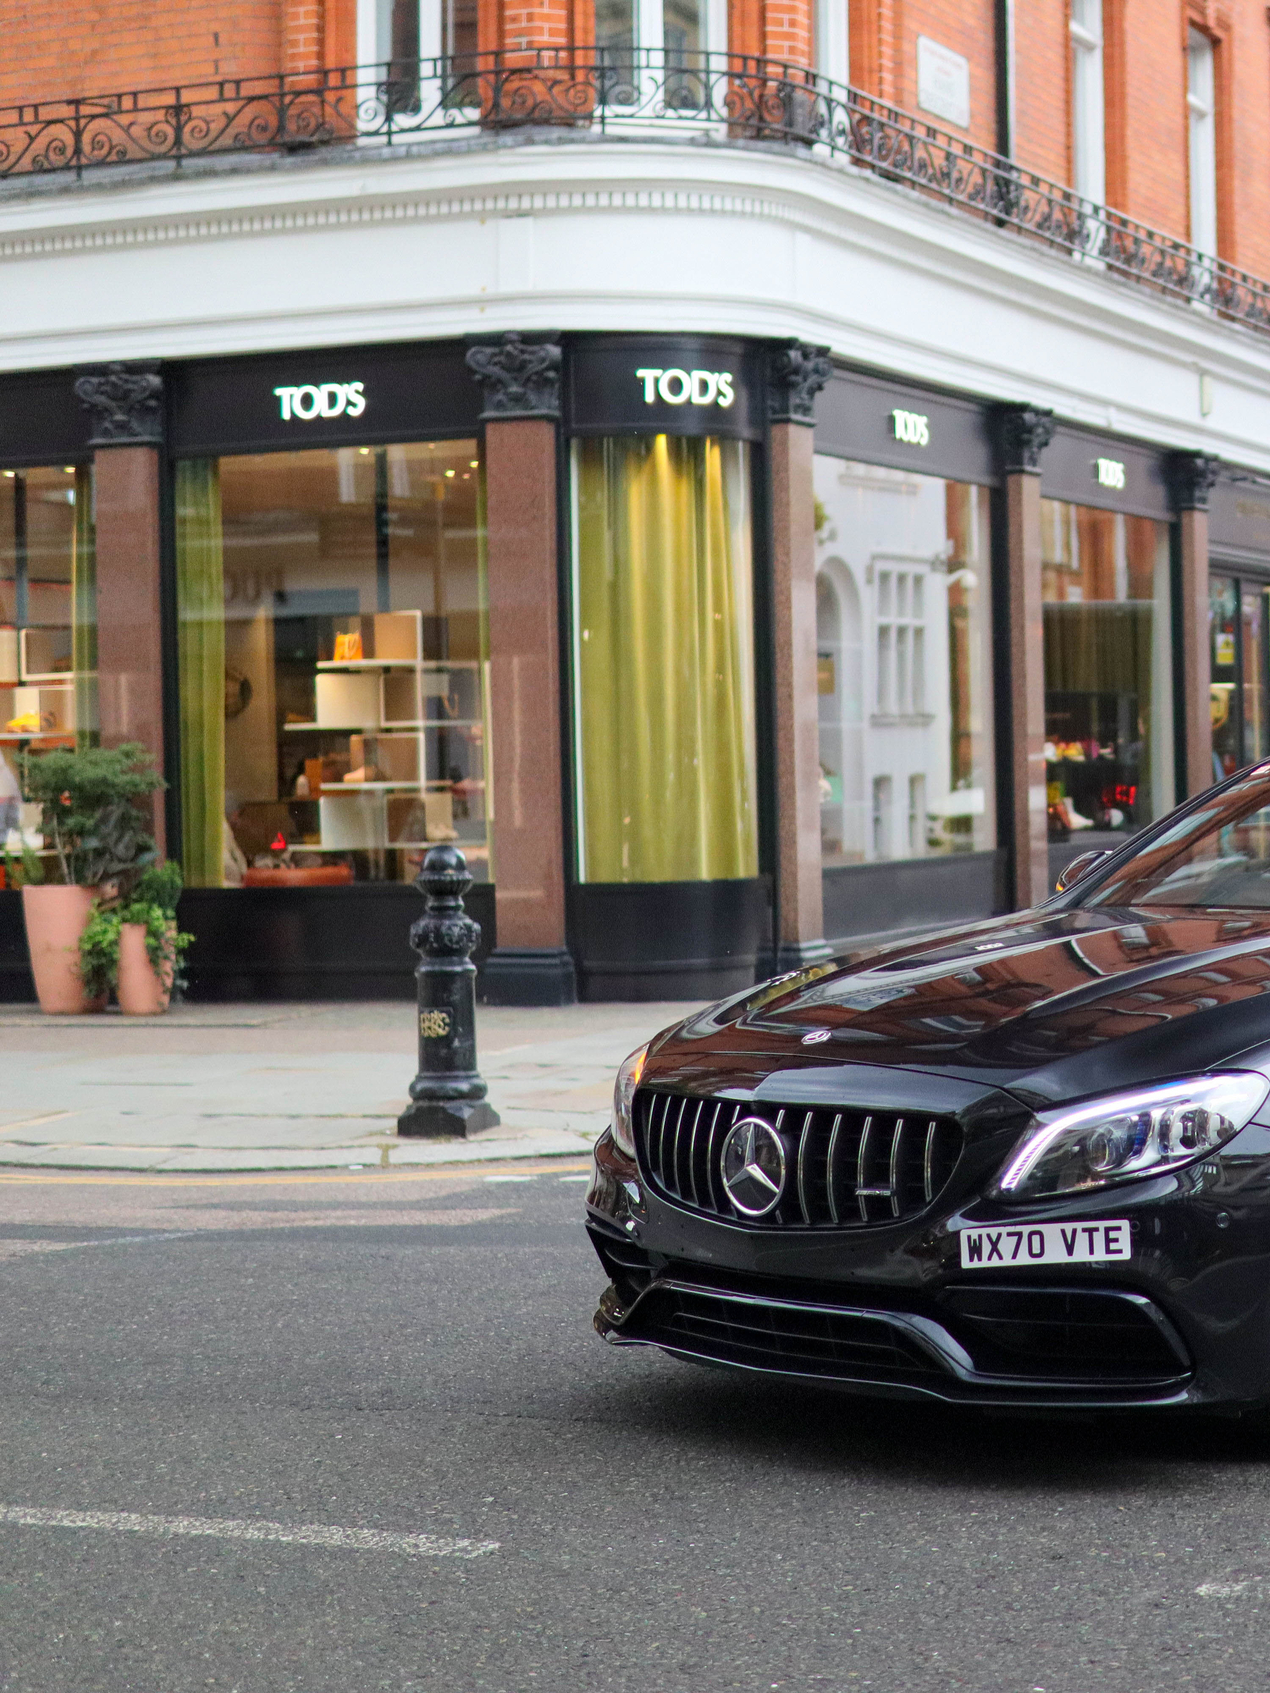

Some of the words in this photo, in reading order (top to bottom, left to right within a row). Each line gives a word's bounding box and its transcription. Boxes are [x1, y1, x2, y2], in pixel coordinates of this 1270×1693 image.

[273, 381, 366, 420] TOD'S
[635, 367, 734, 408] TOD'S
[967, 1230, 1045, 1263] WX70
[1060, 1225, 1124, 1257] VTE
